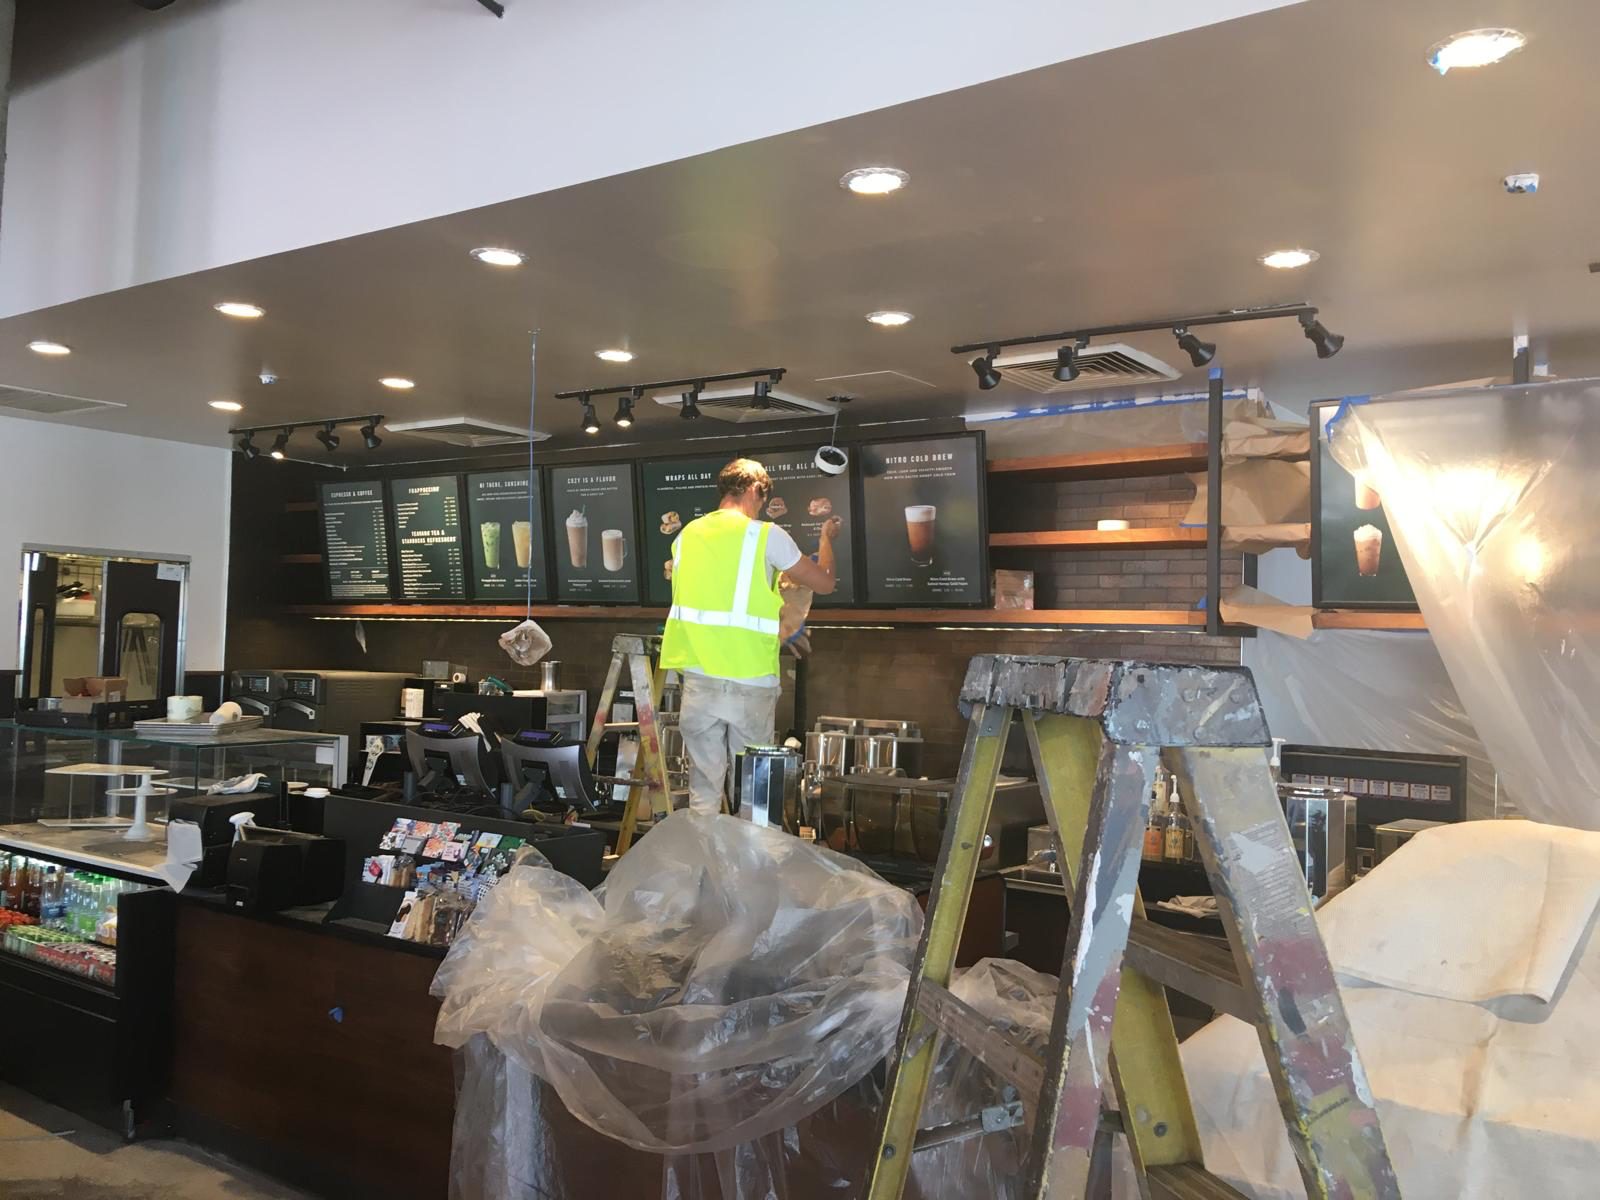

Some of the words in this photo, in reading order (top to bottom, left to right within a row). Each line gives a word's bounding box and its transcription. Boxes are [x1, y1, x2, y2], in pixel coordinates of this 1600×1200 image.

[885, 456, 907, 464] NITRO
[910, 454, 929, 462] COLD
[932, 453, 953, 462] BREW
[665, 474, 685, 482] WRAPS
[700, 472, 712, 480] DAY
